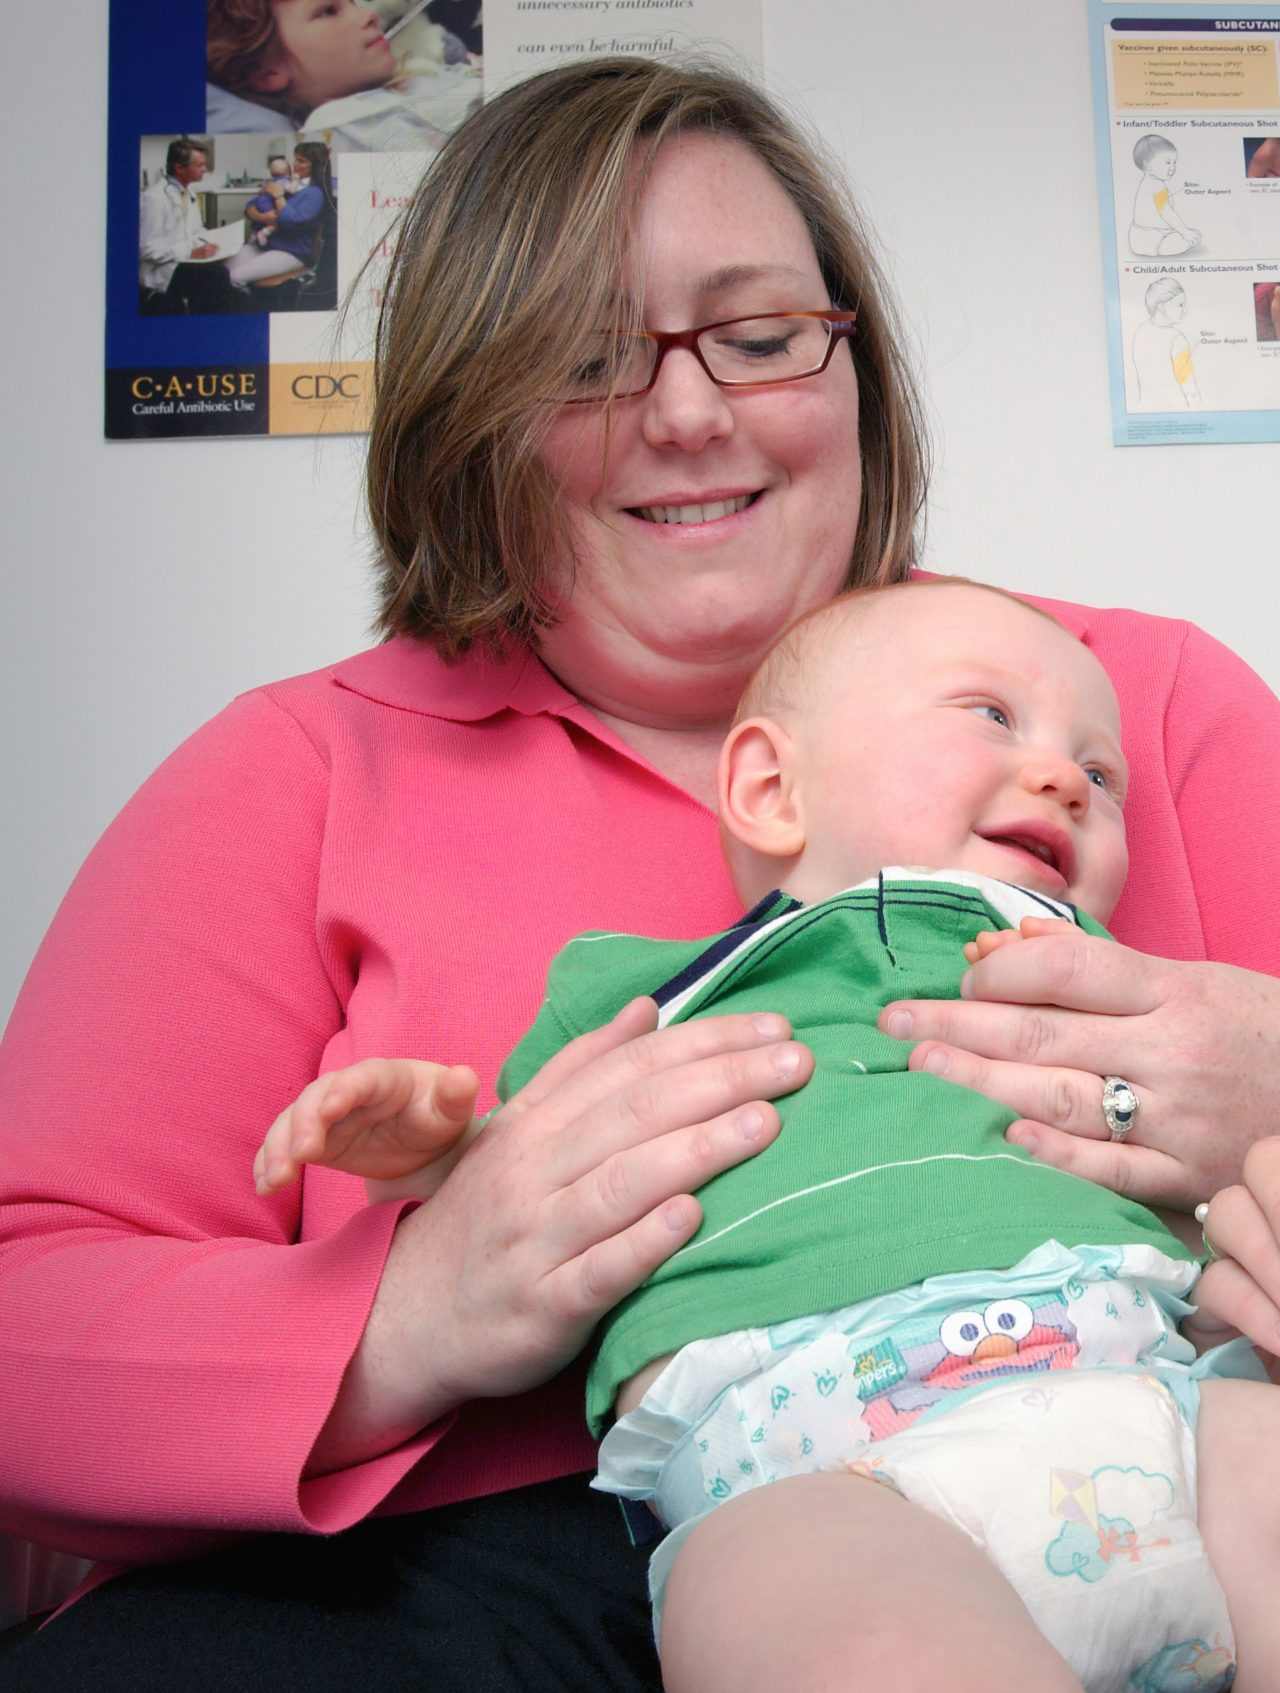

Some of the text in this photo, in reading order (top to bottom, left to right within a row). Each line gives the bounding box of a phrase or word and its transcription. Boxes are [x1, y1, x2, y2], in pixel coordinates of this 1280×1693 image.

[517, 0, 694, 12] unnecessary antibiotics
[517, 41, 545, 54] can
[550, 41, 585, 53] even
[589, 39, 609, 52] be
[1118, 44, 1154, 53] Vaccines
[1157, 44, 1179, 53] given
[1181, 44, 1244, 53] subcutaneously
[1123, 120, 1279, 128] Infant/Toddler Subcutaneous Shot
[1133, 263, 1279, 274] Child/Adult Subcutaneous Shot
[291, 374, 360, 400] CDC
[132, 400, 256, 415] Careful Antibiotic Use
